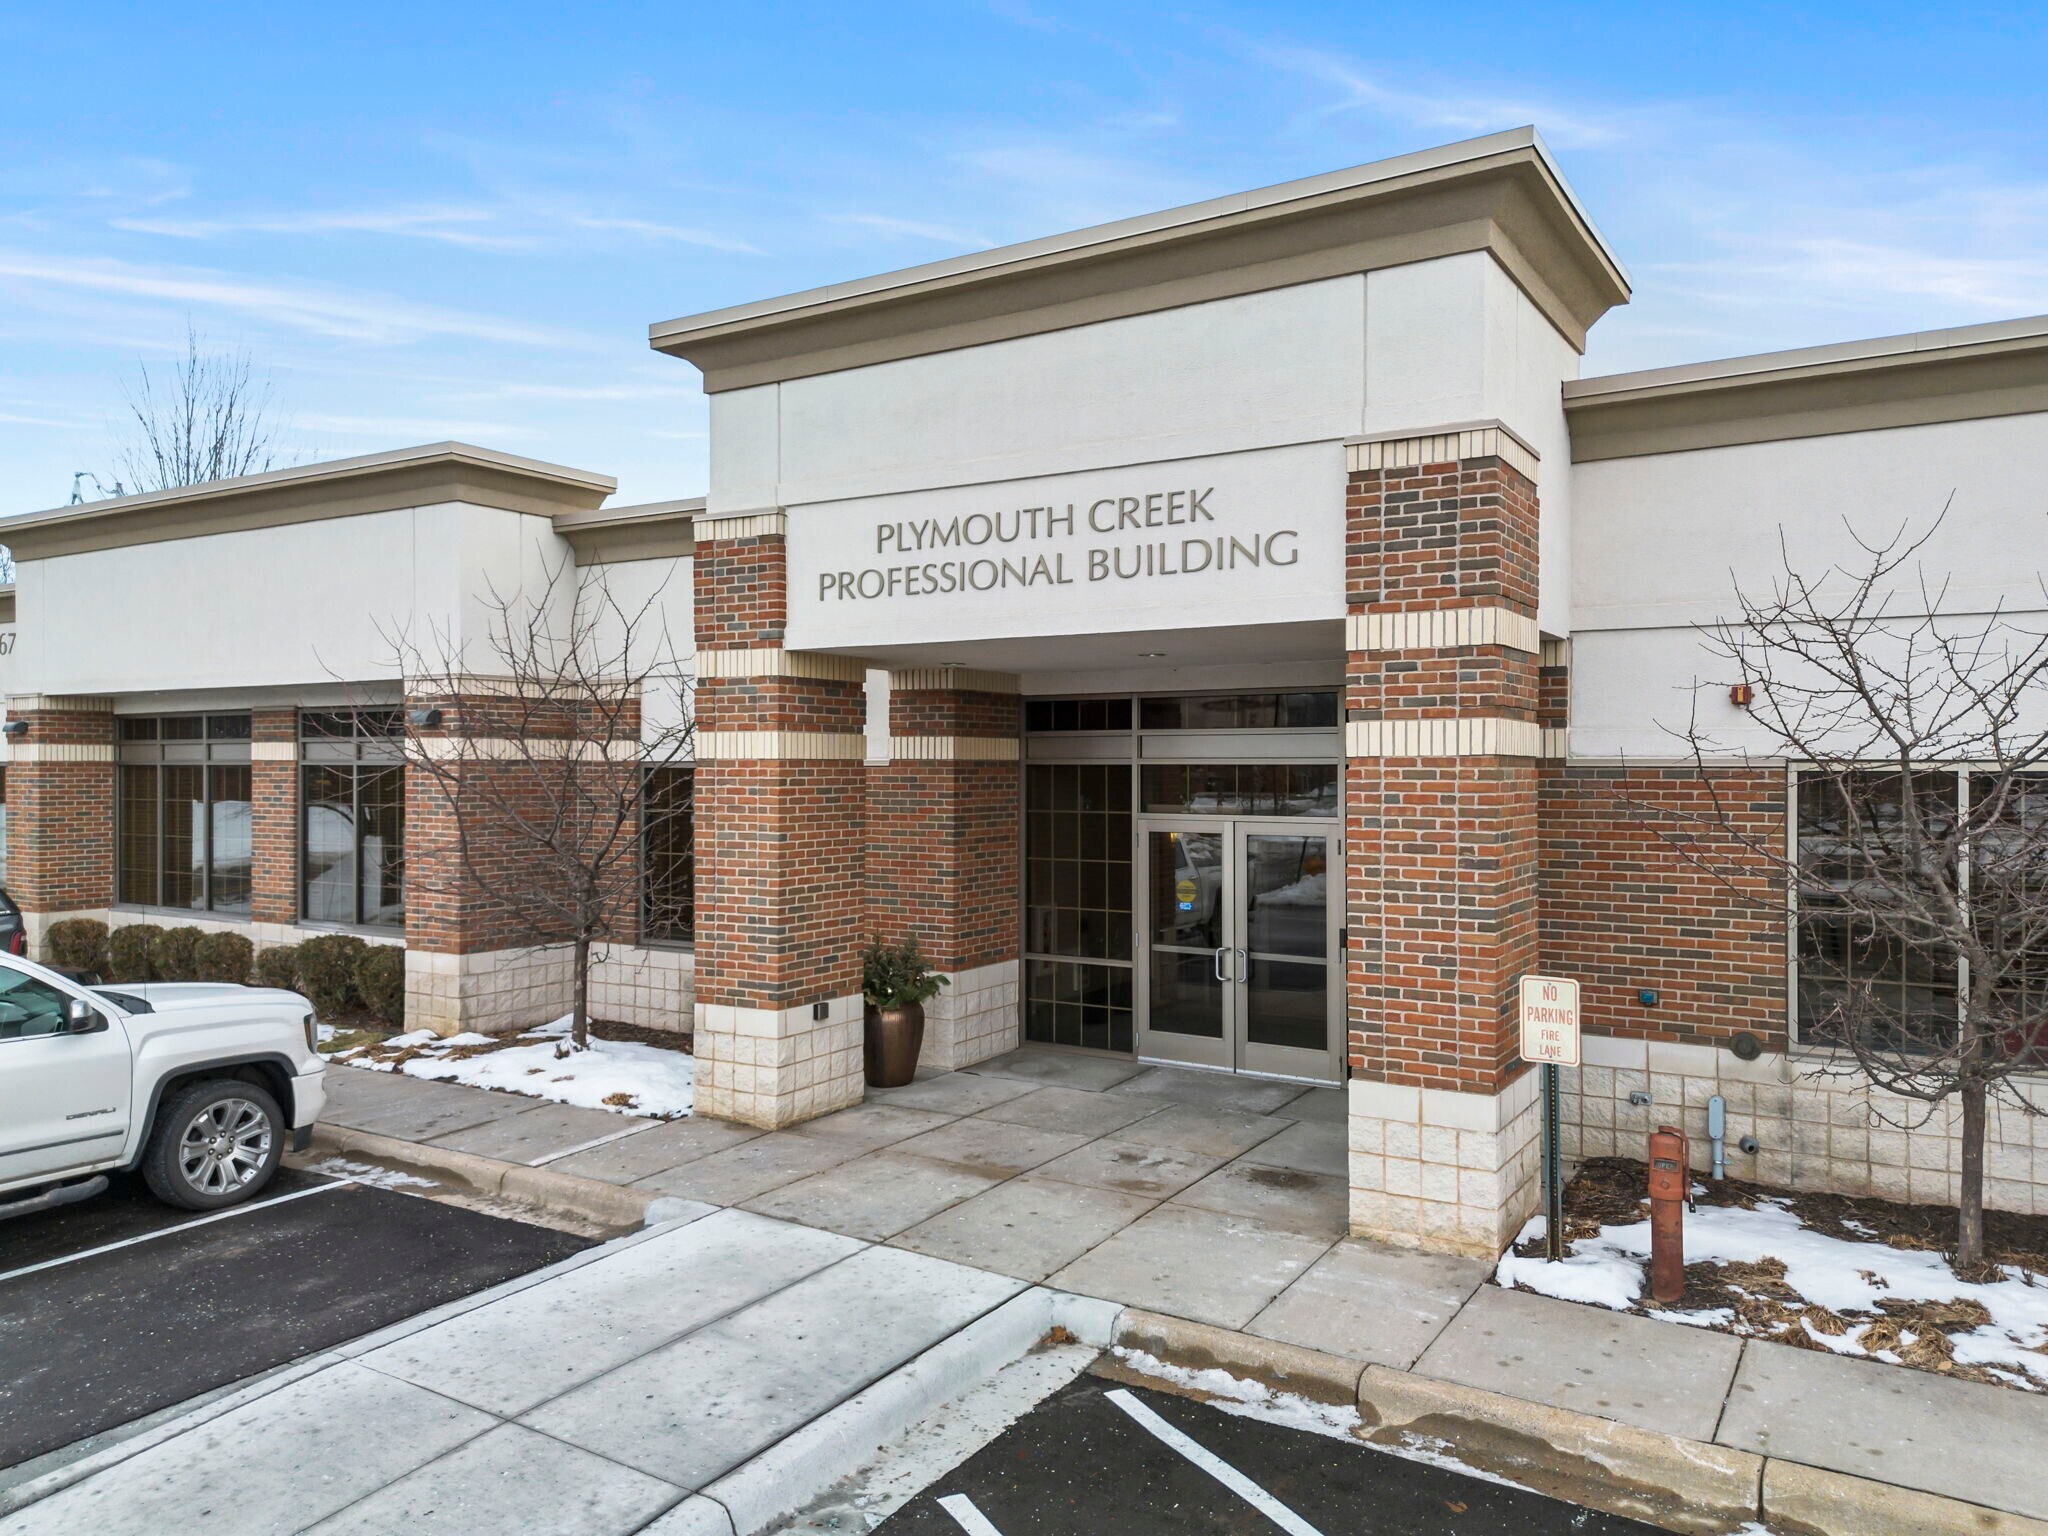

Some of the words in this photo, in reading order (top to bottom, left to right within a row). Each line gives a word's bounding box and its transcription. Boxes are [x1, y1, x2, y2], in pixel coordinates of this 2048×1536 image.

[877, 503, 1074, 554] PLYMOUTH
[1088, 486, 1215, 533] CREEK
[819, 552, 1074, 602] PROFESSIONAL
[1088, 529, 1298, 582] BUILDING
[1542, 985, 1557, 1001] NO
[1527, 1006, 1573, 1025] PARKING
[1541, 1029, 1560, 1041] FIRE
[1539, 1045, 1562, 1057] LANE
